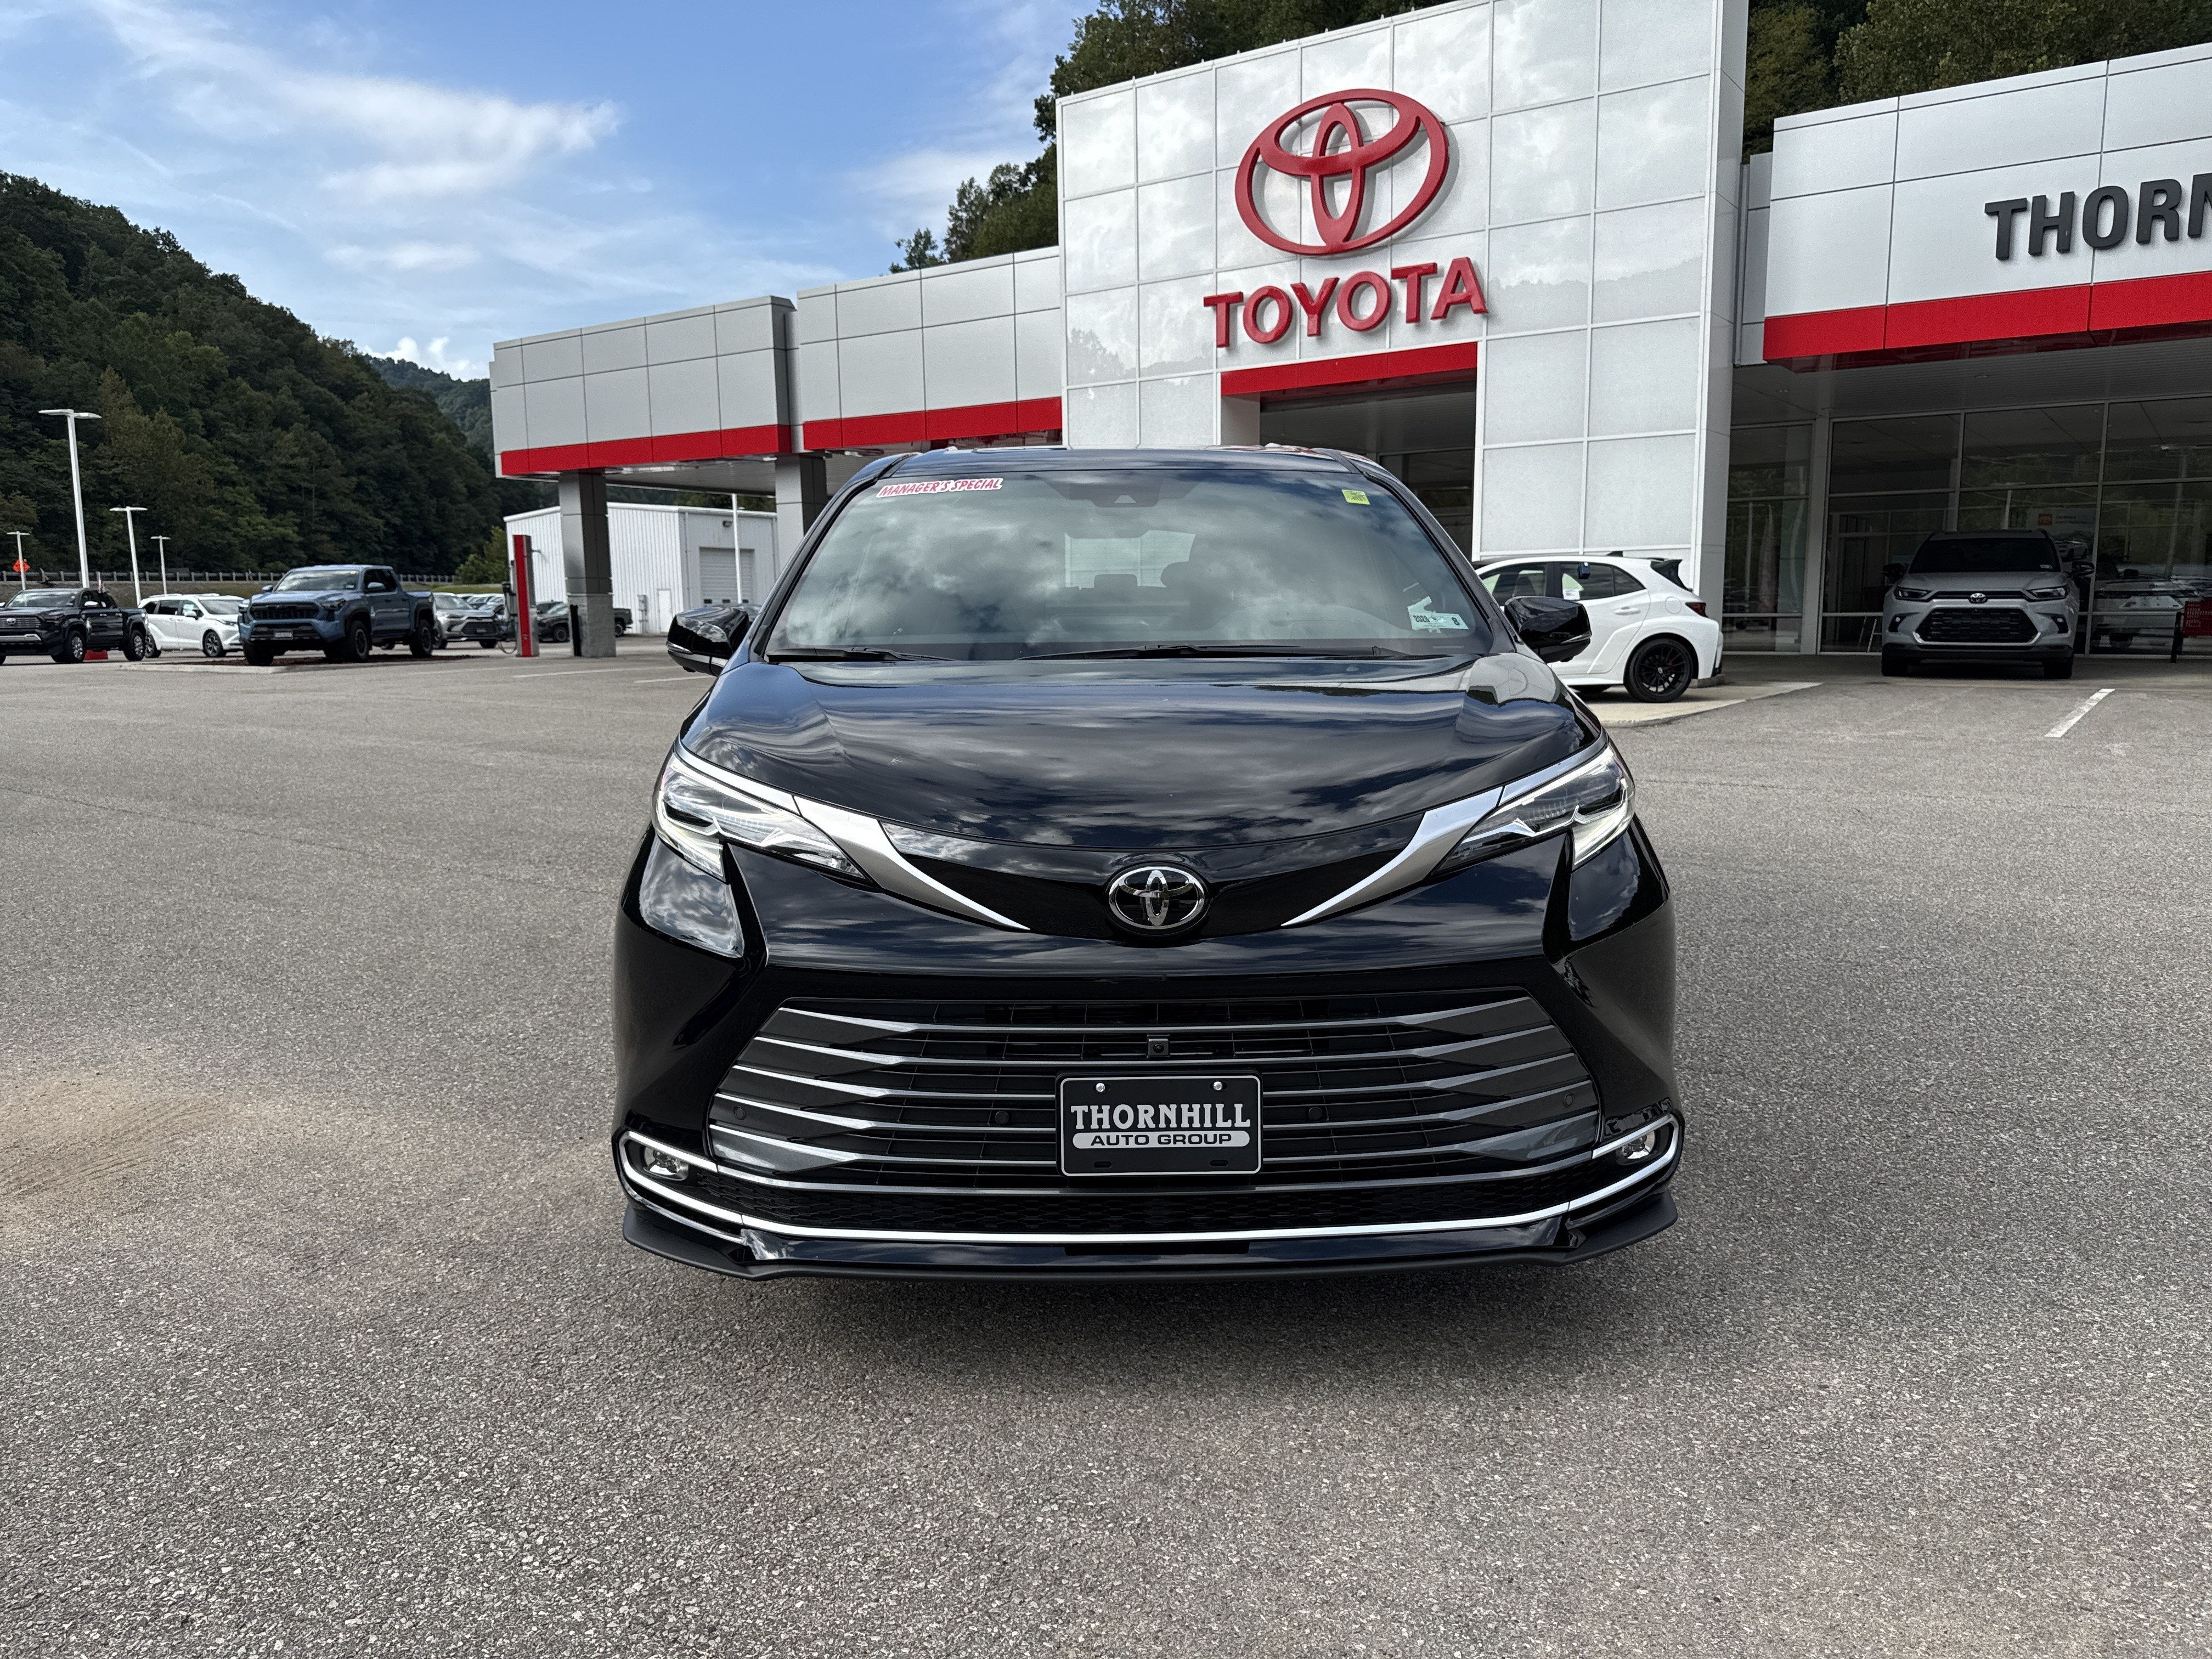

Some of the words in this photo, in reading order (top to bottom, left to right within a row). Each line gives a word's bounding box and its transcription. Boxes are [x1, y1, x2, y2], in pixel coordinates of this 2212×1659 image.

[1204, 257, 1487, 347] TOYOTA
[879, 482, 950, 495] MANAGER'S
[951, 479, 1000, 490] SPECIAL
[1071, 1103, 1250, 1129] THORNHILL
[1091, 1135, 1149, 1146] AUTO
[1158, 1133, 1232, 1144] GROUP
